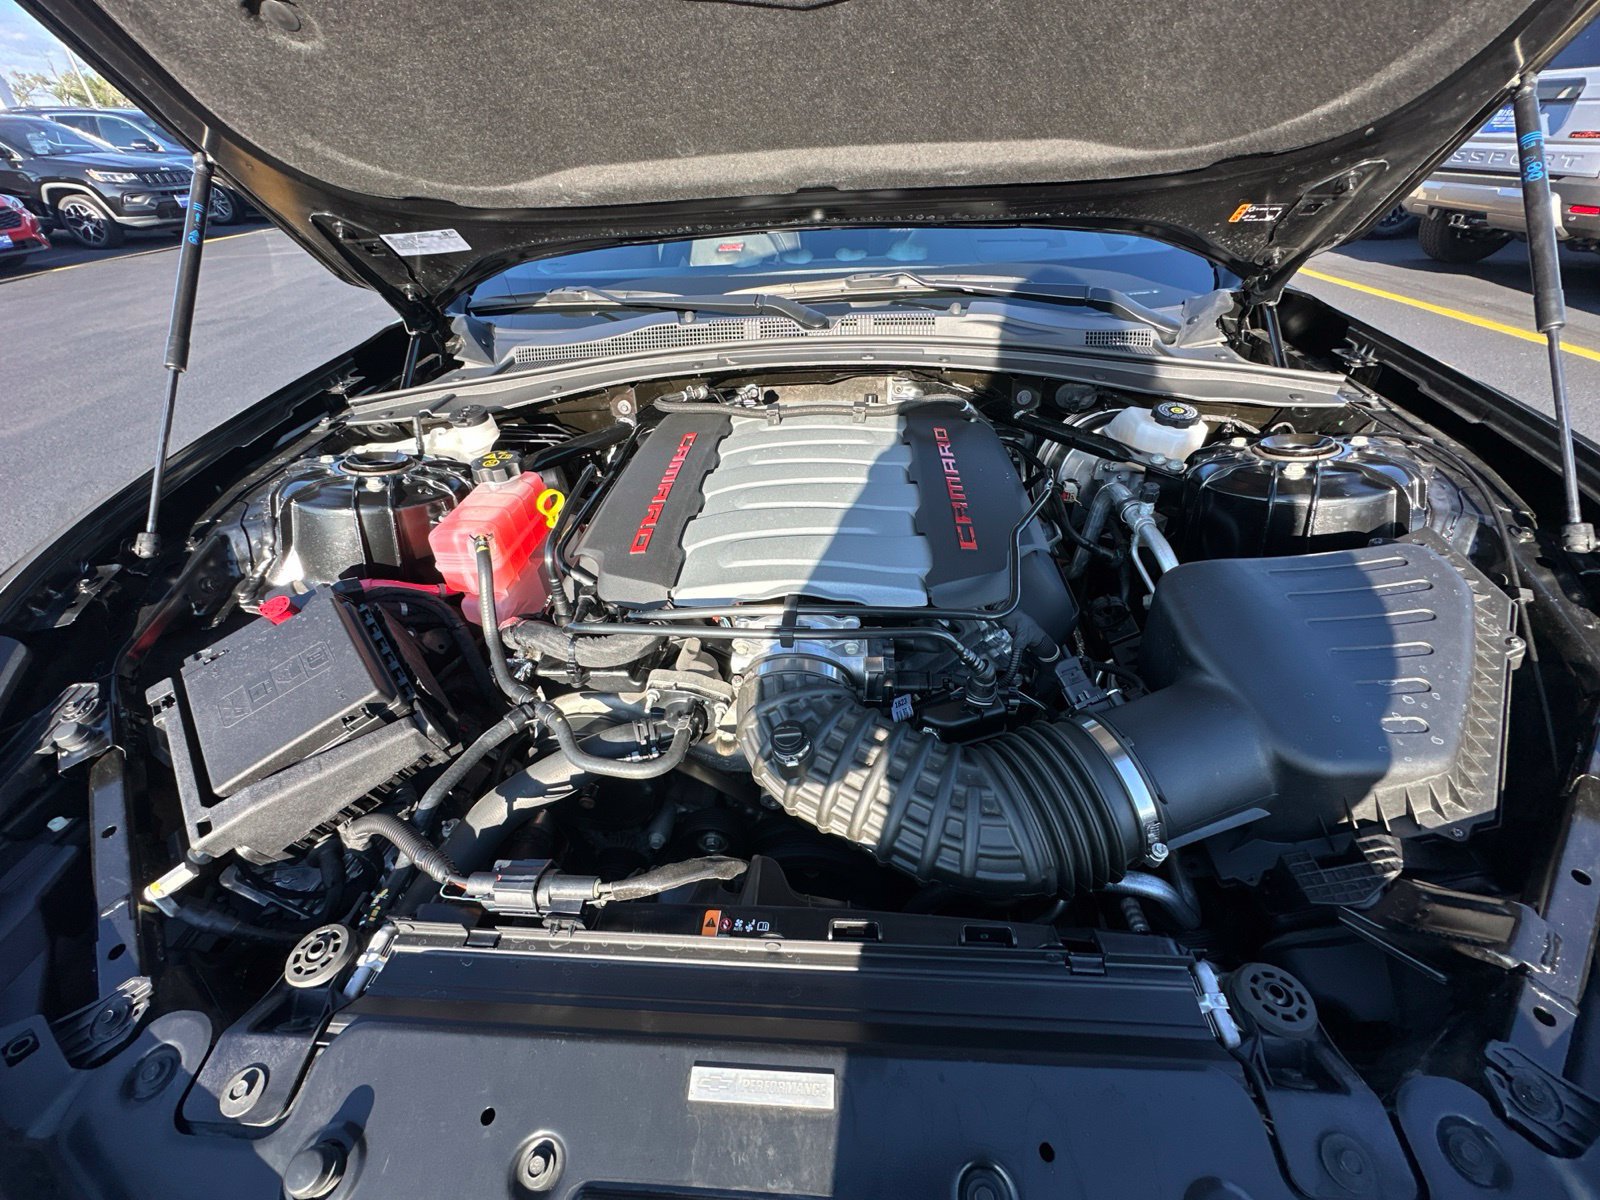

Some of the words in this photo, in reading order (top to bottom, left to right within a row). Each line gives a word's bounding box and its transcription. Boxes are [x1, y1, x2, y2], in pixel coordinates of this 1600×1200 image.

[628, 431, 699, 554] CAMARO
[933, 426, 978, 550] CAMARO
[741, 1076, 828, 1098] PERFORMANCE
